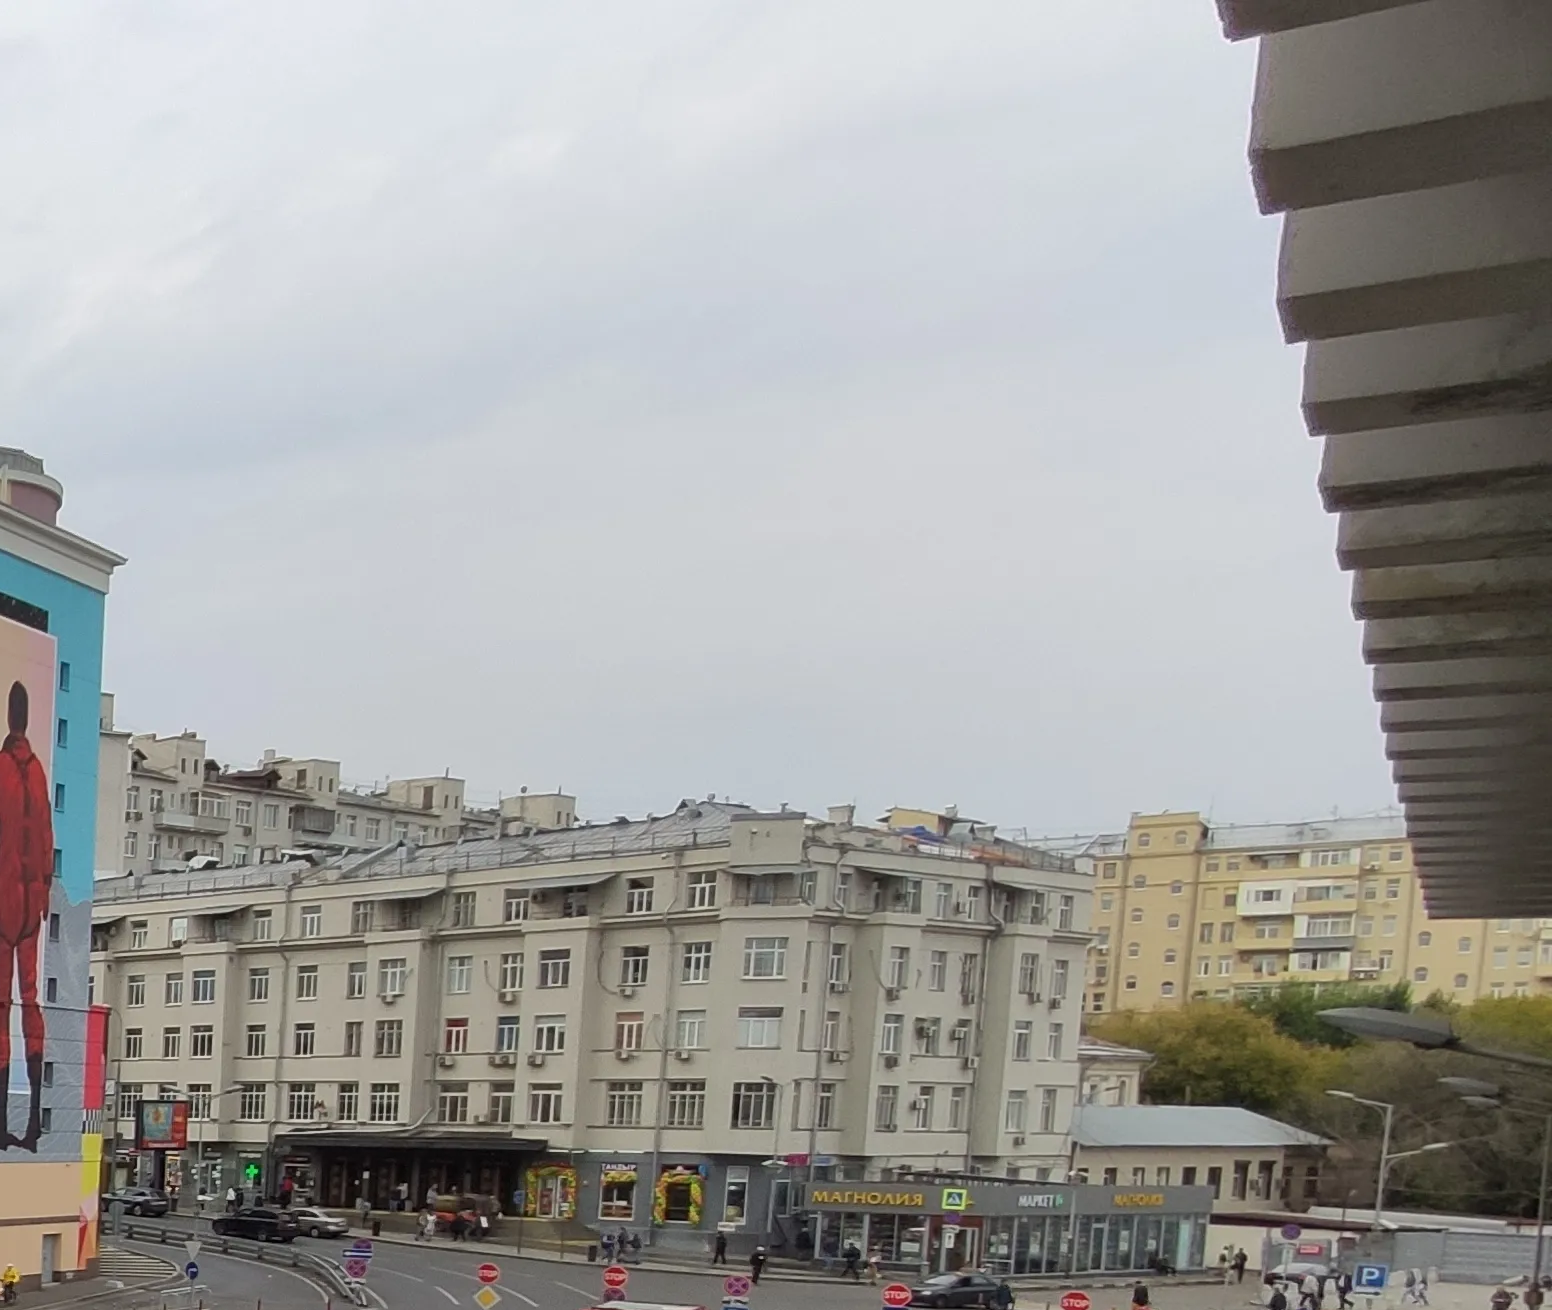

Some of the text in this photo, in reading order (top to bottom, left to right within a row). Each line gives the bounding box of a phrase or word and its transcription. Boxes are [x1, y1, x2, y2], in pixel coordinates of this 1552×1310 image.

[811, 1191, 924, 1207] МАГНОЛИЯ
[883, 1289, 911, 1301] STOP
[1062, 1297, 1090, 1308] STOP
